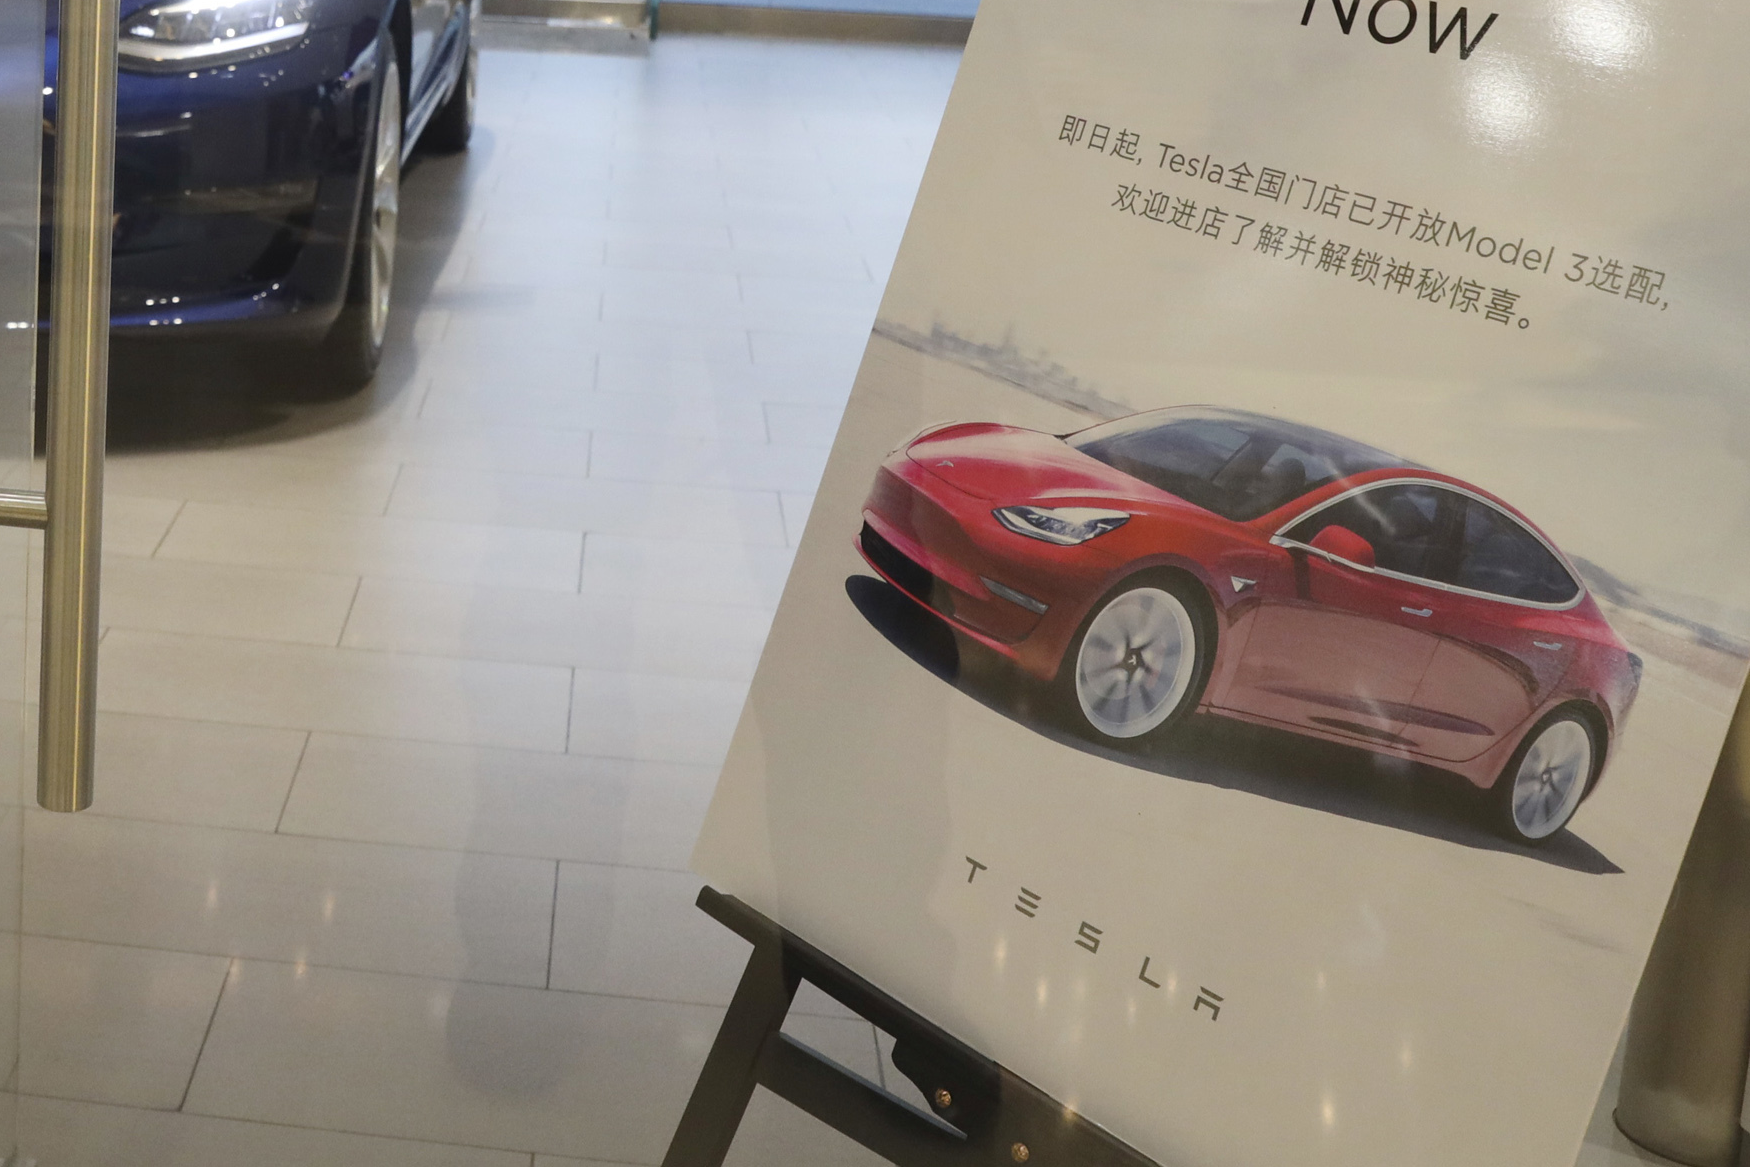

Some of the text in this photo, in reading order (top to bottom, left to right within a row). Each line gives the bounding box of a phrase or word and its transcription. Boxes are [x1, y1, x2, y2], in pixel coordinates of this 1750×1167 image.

[1110, 182, 1530, 330] 欢迎进店了解并解锁神秘惊喜。
[964, 855, 1225, 1022] TESLA
